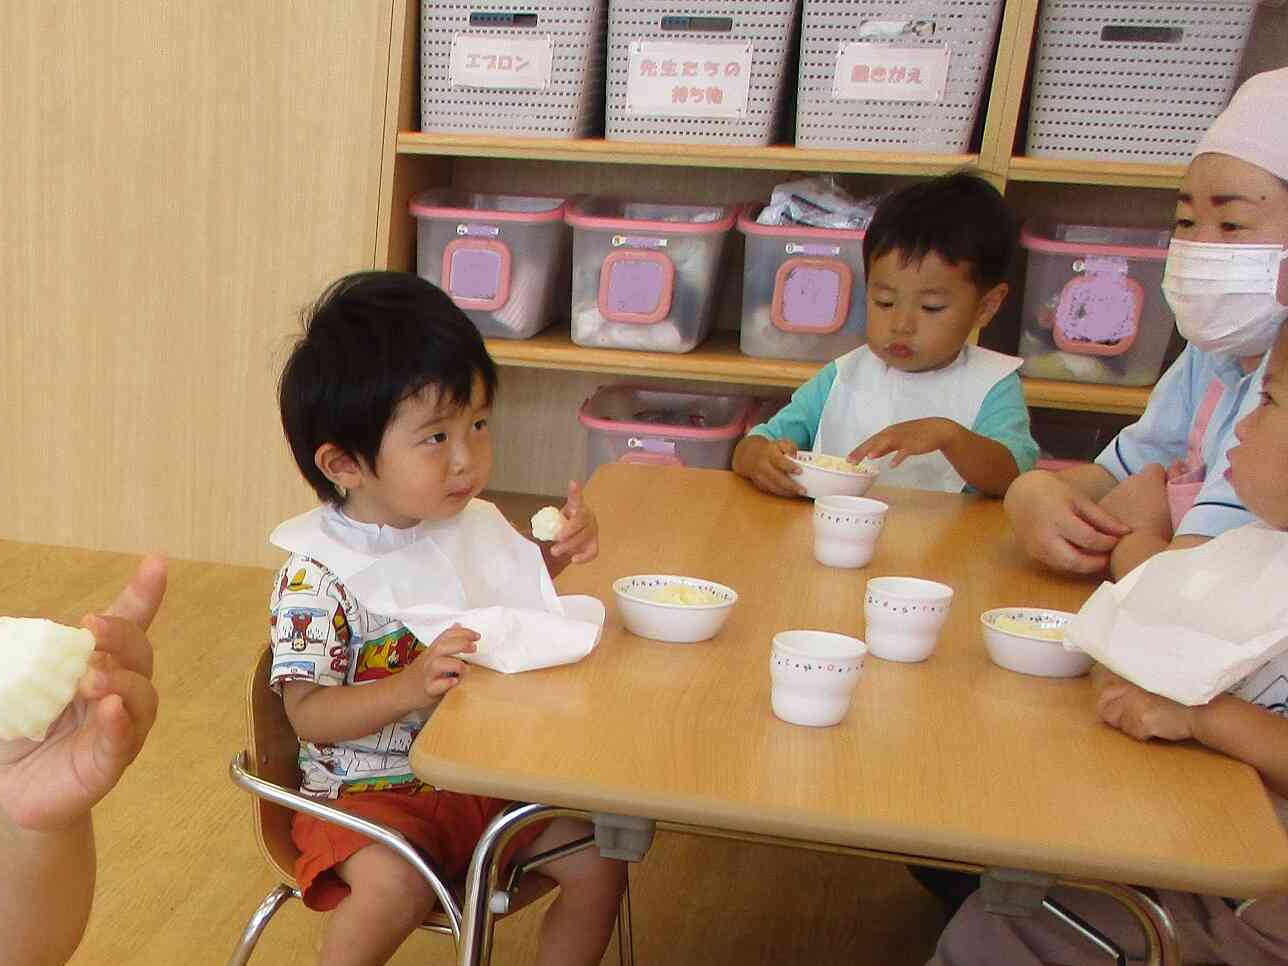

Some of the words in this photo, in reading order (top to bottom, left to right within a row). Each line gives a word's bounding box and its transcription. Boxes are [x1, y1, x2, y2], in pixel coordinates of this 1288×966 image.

[465, 53, 530, 72] エプロン
[639, 59, 741, 78] 先生たちの
[671, 86, 724, 104] 持ち物
